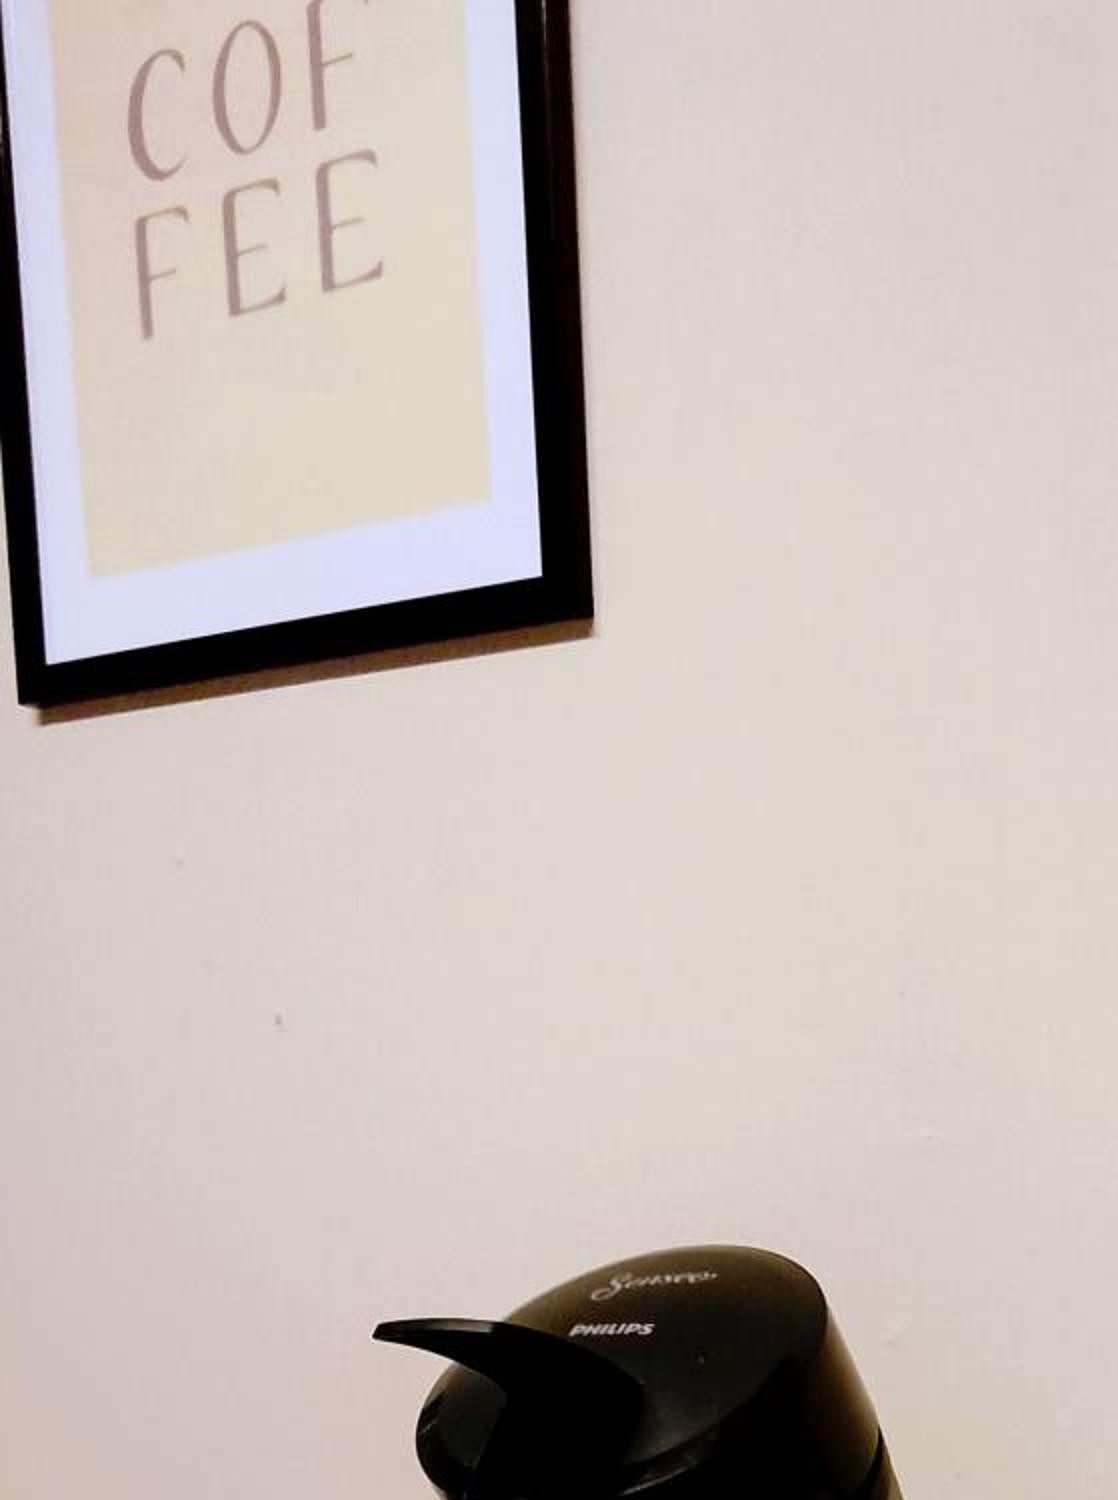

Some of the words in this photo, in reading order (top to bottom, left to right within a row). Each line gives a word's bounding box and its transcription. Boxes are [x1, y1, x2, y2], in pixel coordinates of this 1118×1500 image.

[127, 0, 368, 181] COF
[133, 148, 384, 340] FEE
[568, 1322, 655, 1337] PHILIPS
